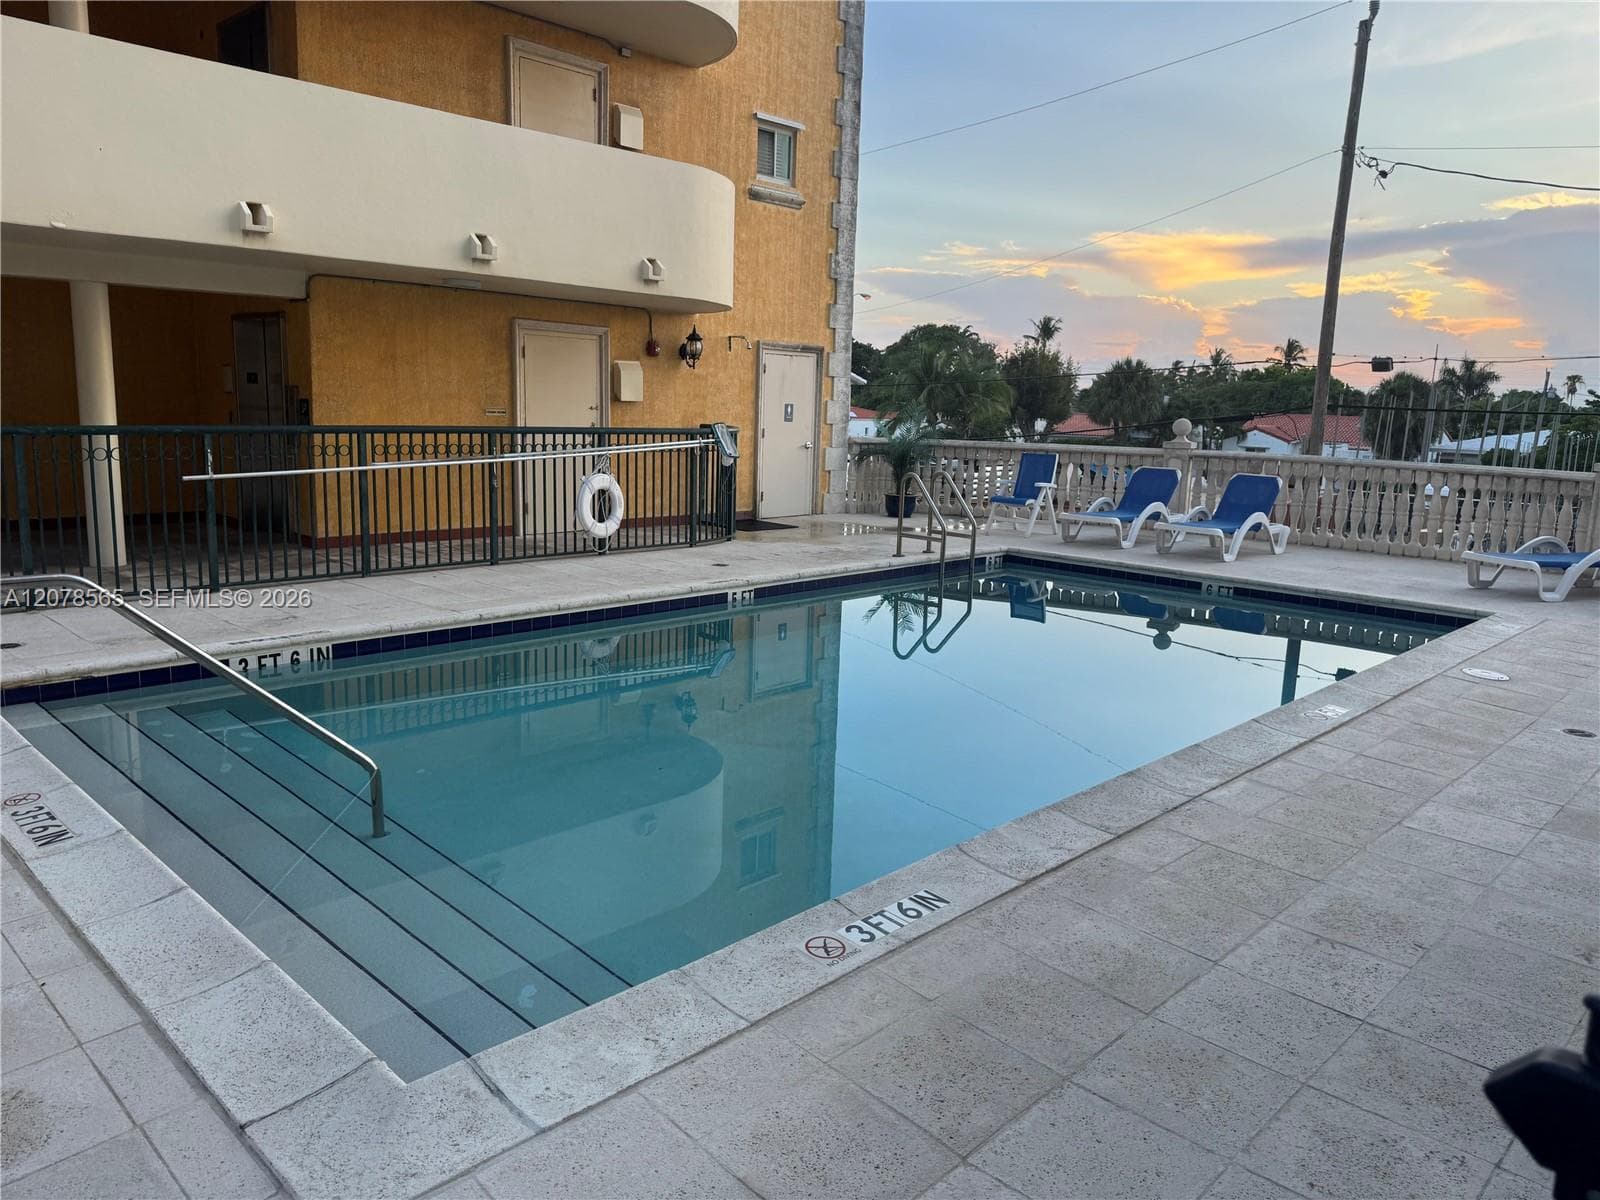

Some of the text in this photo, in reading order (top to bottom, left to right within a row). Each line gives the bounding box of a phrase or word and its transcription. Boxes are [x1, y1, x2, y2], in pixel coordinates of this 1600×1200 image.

[257, 652, 281, 671] FT
[290, 650, 301, 665] 6
[309, 646, 330, 662] IN
